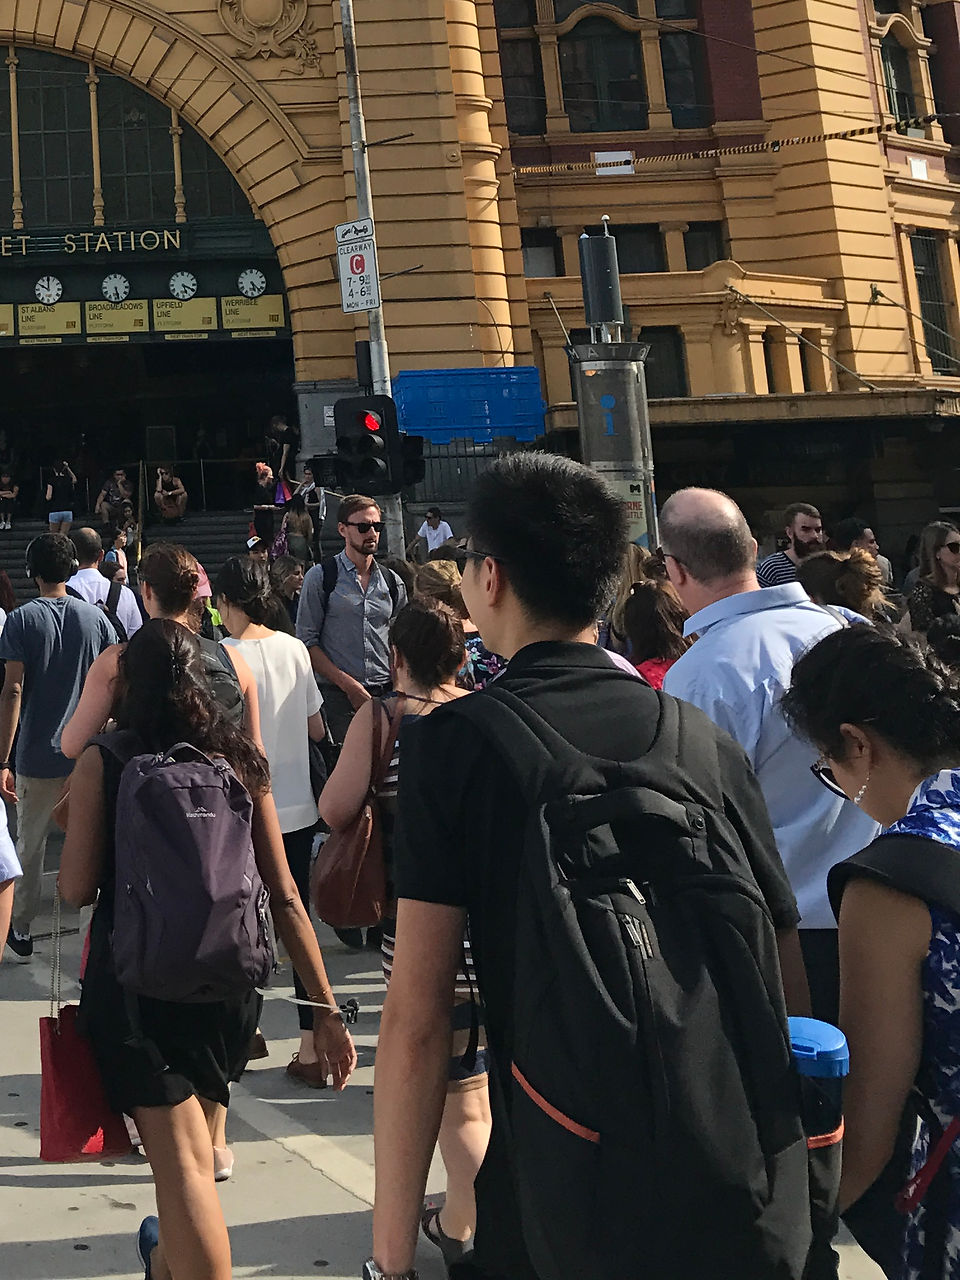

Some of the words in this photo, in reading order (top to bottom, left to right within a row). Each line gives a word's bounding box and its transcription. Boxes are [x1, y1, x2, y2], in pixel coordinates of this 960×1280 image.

[64, 229, 181, 254] STATION
[339, 242, 372, 255] CLEARWAY
[353, 256, 362, 273] C
[88, 302, 143, 311] BROADMEADOWS
